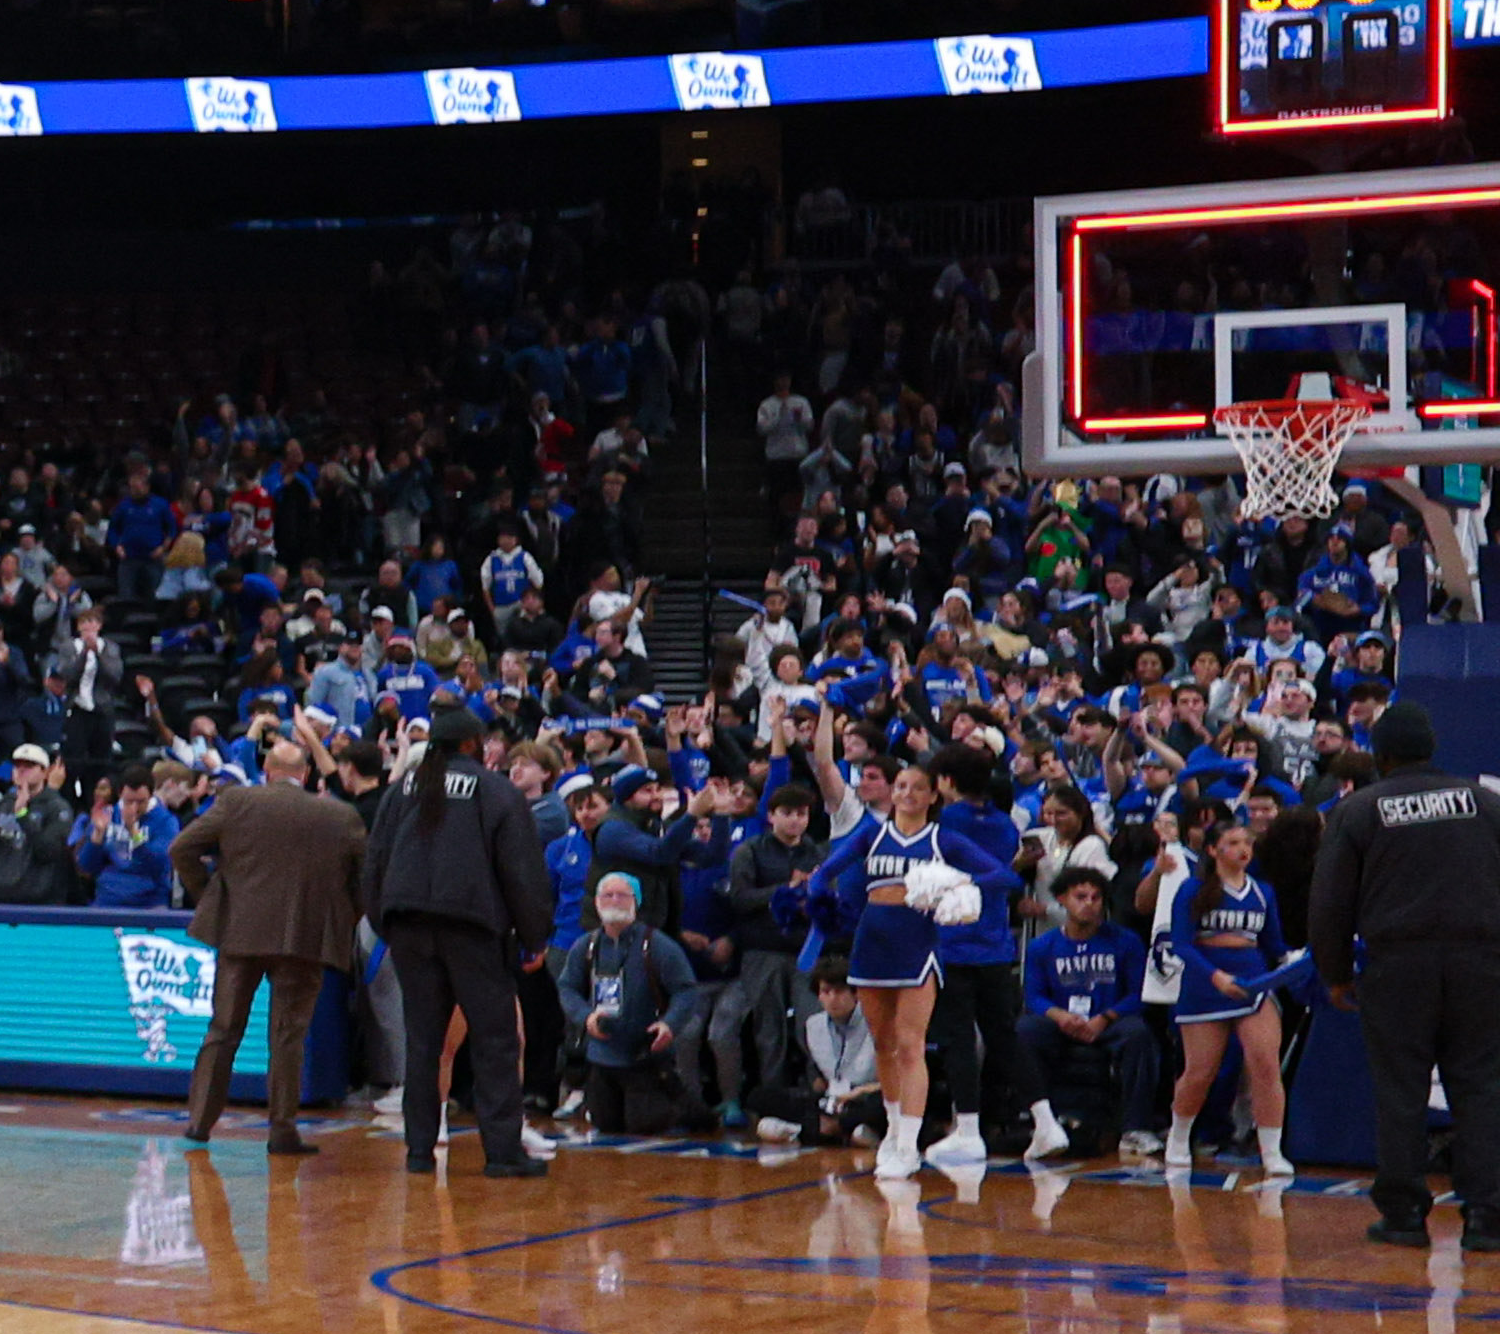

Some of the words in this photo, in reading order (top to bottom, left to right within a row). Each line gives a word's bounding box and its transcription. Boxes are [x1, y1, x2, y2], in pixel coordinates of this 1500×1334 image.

[1382, 789, 1470, 823] SECURITY
[153, 948, 182, 976] We
[137, 969, 181, 995] Own
